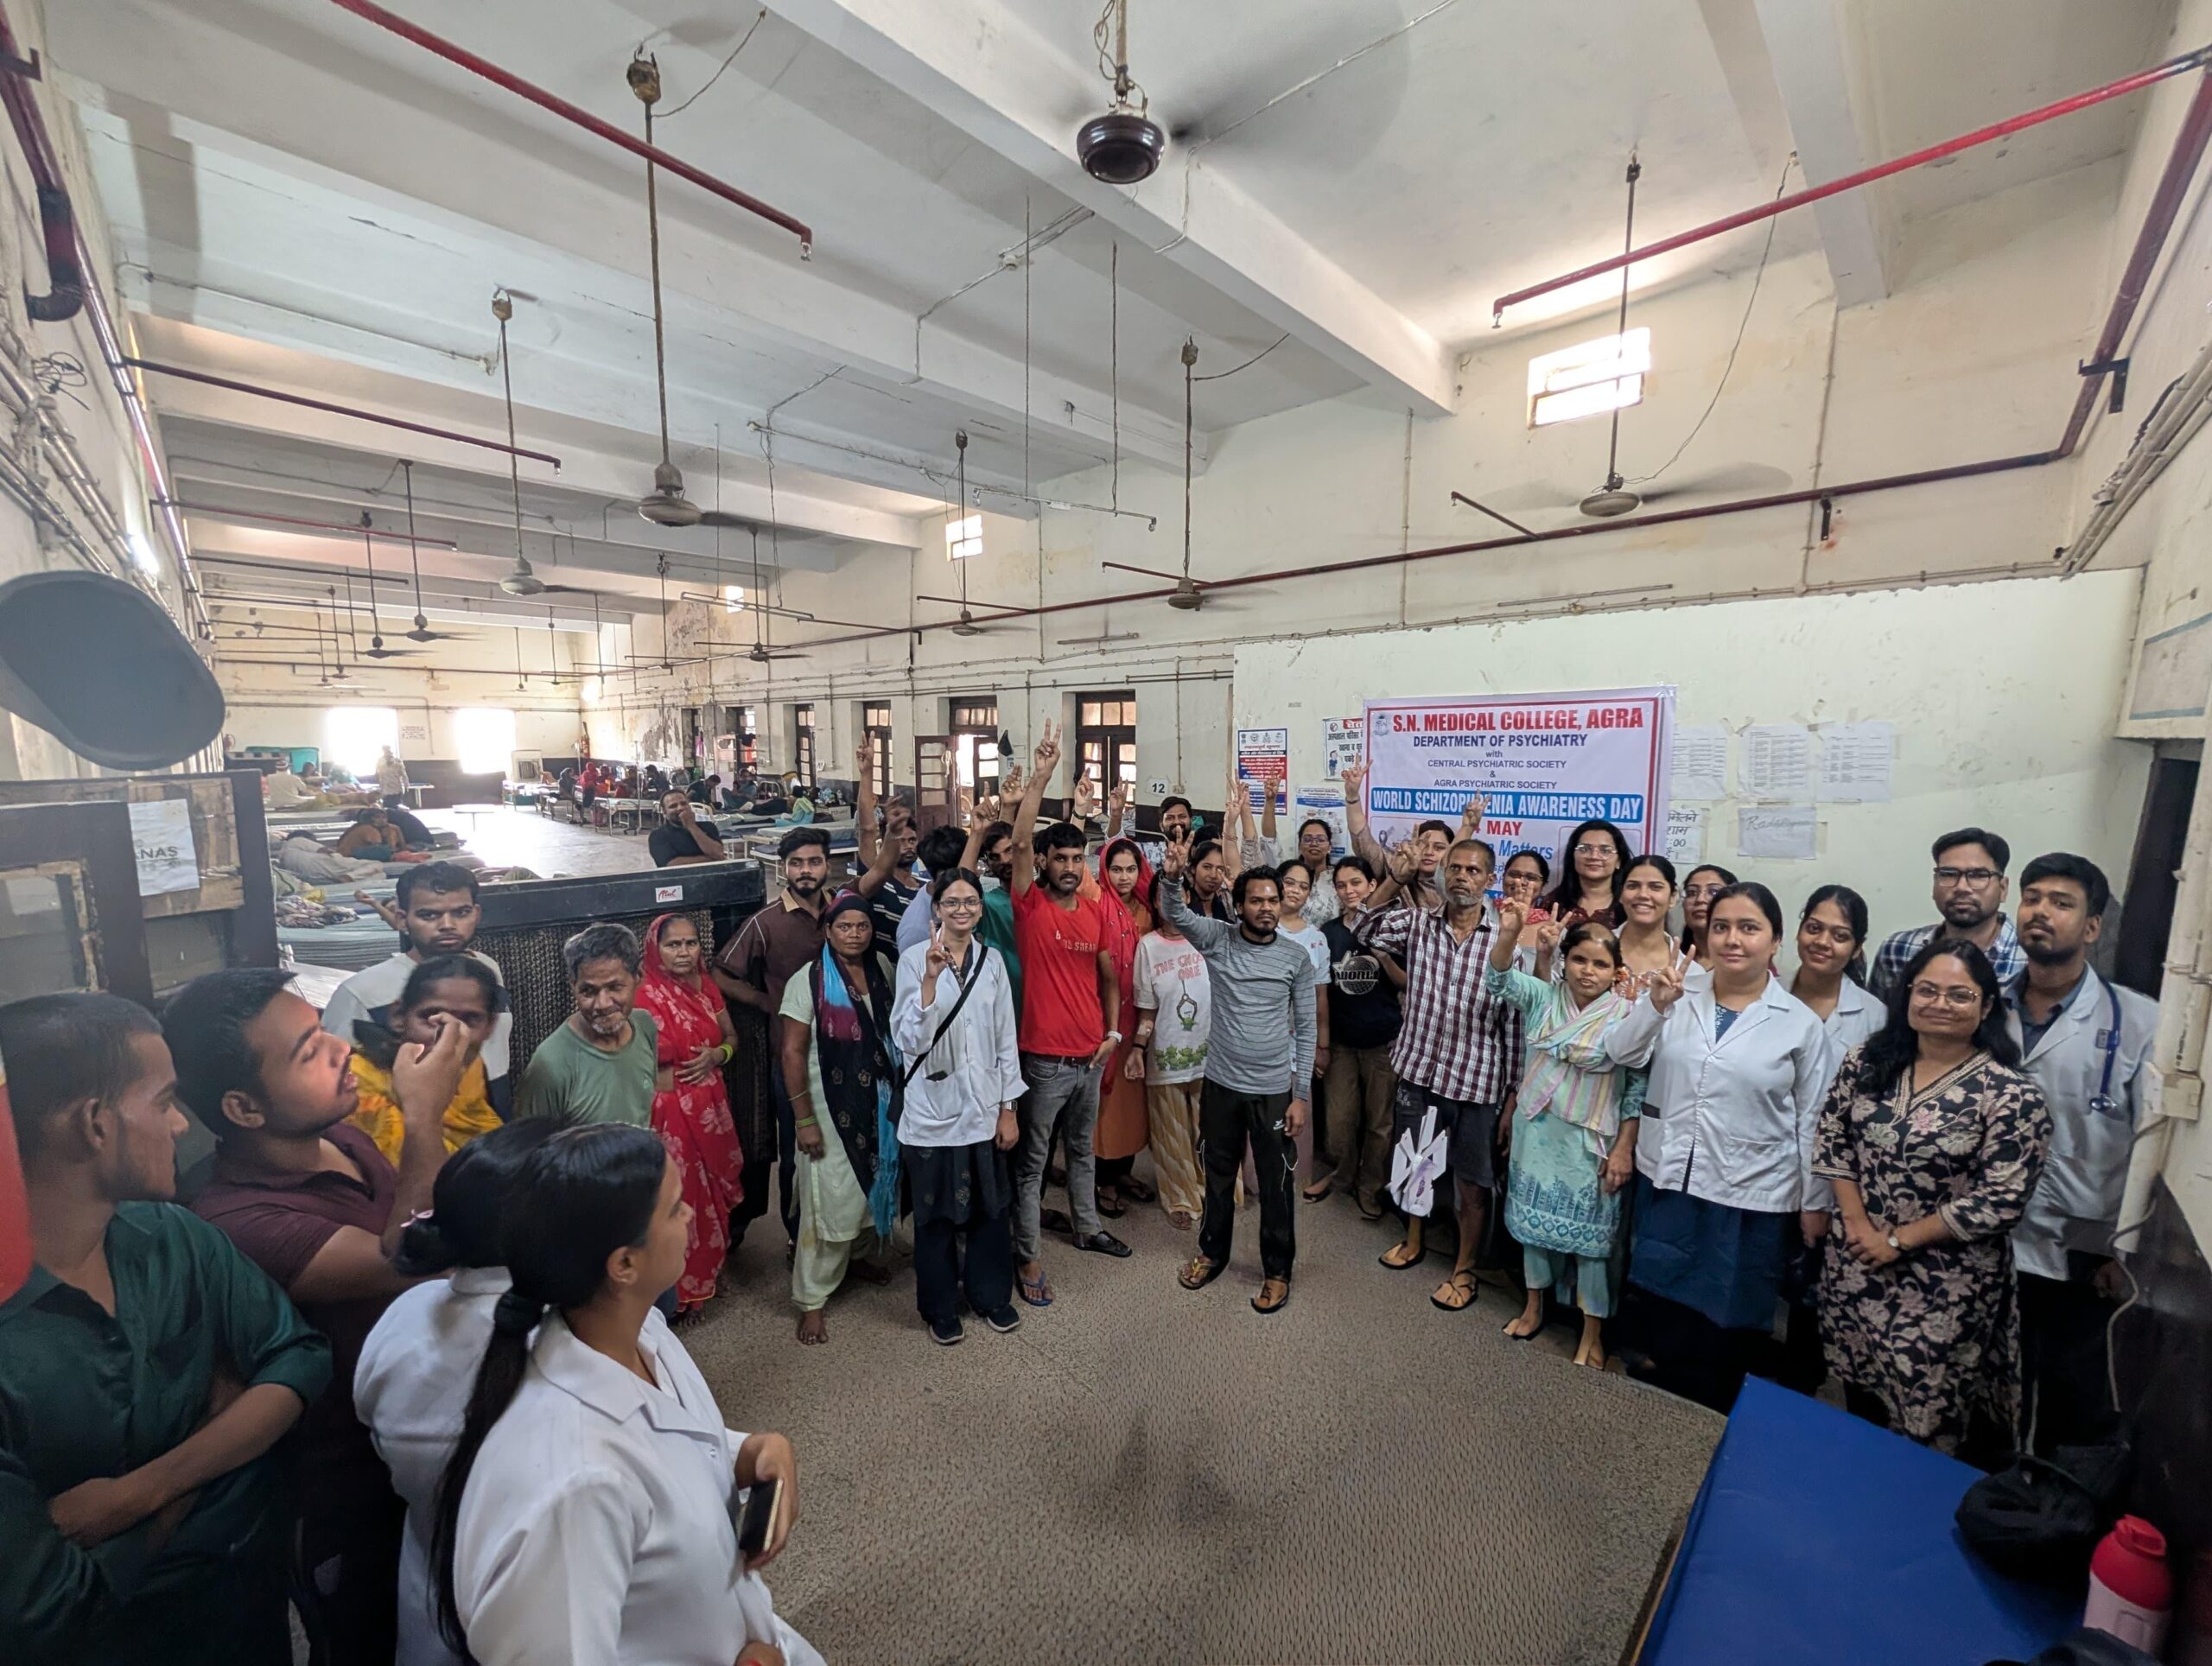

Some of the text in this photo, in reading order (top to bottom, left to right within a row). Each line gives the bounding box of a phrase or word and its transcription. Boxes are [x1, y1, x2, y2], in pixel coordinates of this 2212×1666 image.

[1393, 707, 1643, 732] S.N. MEDICAL COLLEGE, AGRA
[1414, 734, 1588, 747] DEPARTMENT OF PSYCHIATRY
[1152, 783, 1165, 793] 12
[1459, 779, 1515, 788] PSYCHIATRIC
[1517, 780, 1557, 789] SOCIETY
[1373, 790, 1411, 810] WORLD
[1518, 794, 1605, 818] AWARENESS
[1610, 798, 1642, 819] DAY
[1486, 820, 1522, 836] MAY
[136, 846, 179, 860] NAS
